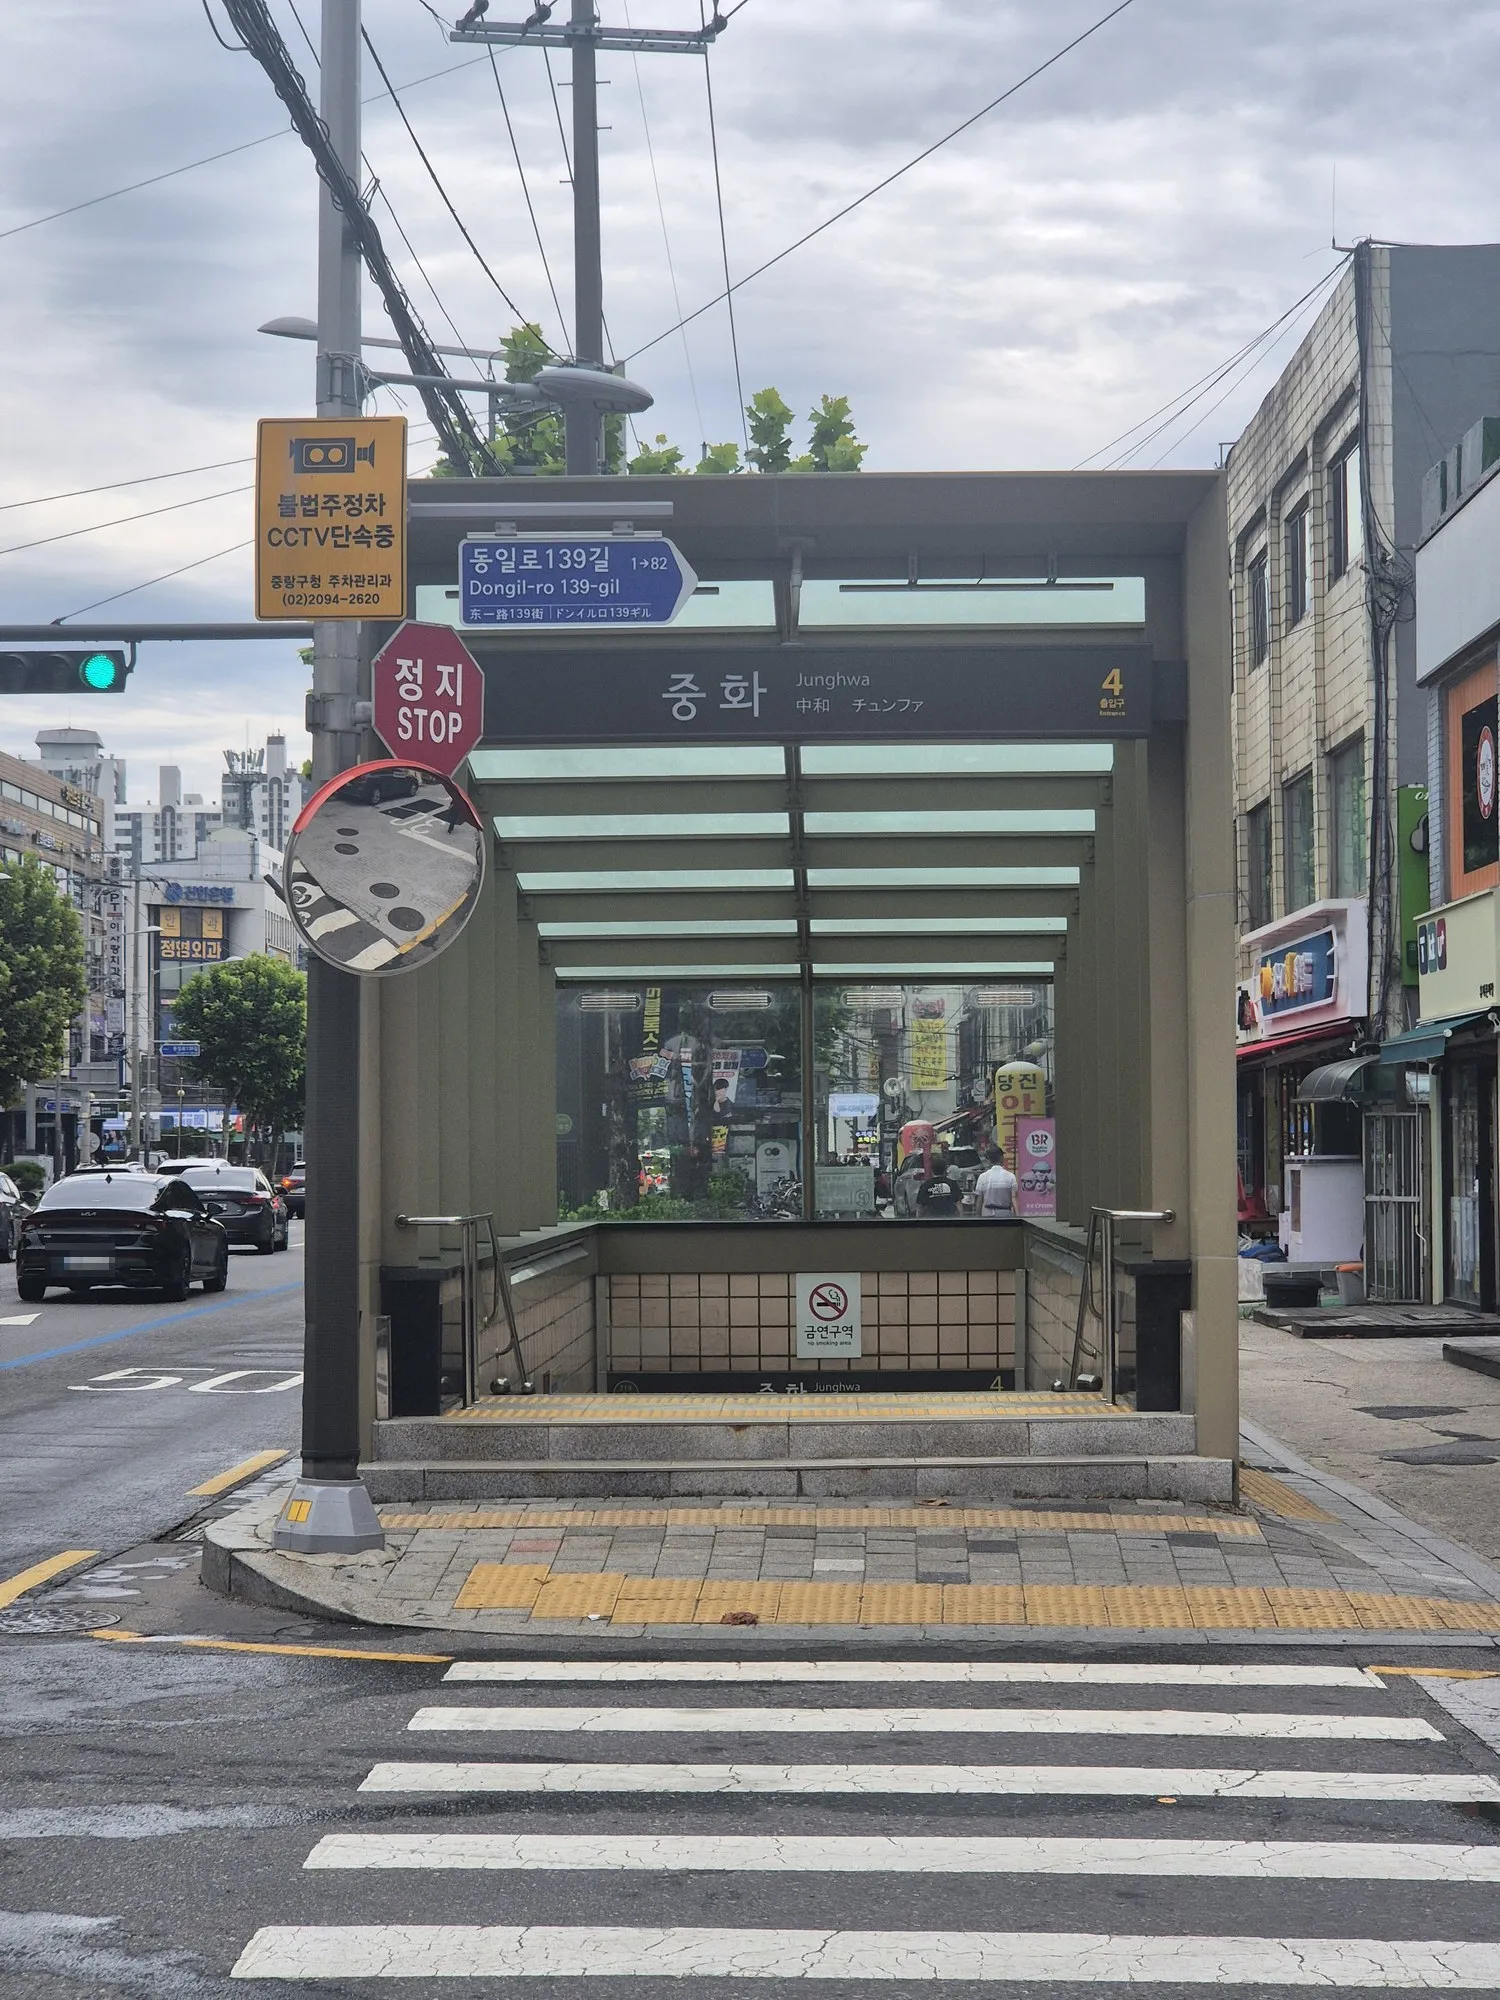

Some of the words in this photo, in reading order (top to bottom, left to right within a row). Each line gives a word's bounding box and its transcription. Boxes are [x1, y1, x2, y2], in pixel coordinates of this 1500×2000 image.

[277, 493, 386, 518] 불법주정차
[267, 524, 395, 549] CCTV단속중
[469, 546, 609, 574] 동일로139길
[271, 575, 321, 589] 중랑구청
[328, 574, 392, 588] 주차관리과
[469, 579, 554, 598] Dongil-ro
[560, 578, 620, 598] 139-gil
[282, 593, 380, 606] (02)2094-2620
[469, 607, 544, 620] 东一路139街
[555, 607, 651, 619] ドンイルロ139ギル
[796, 672, 870, 690] Junghwa
[1101, 668, 1124, 696] 4
[661, 670, 768, 721] 중화
[796, 697, 830, 714] 中和
[851, 698, 924, 713] チュンファ
[397, 706, 463, 744] STOP
[997, 1072, 1038, 1092] 당진
[804, 1324, 853, 1339] 금연구역
[814, 1381, 861, 1394] Junghwa
[989, 1375, 1004, 1392] 4
